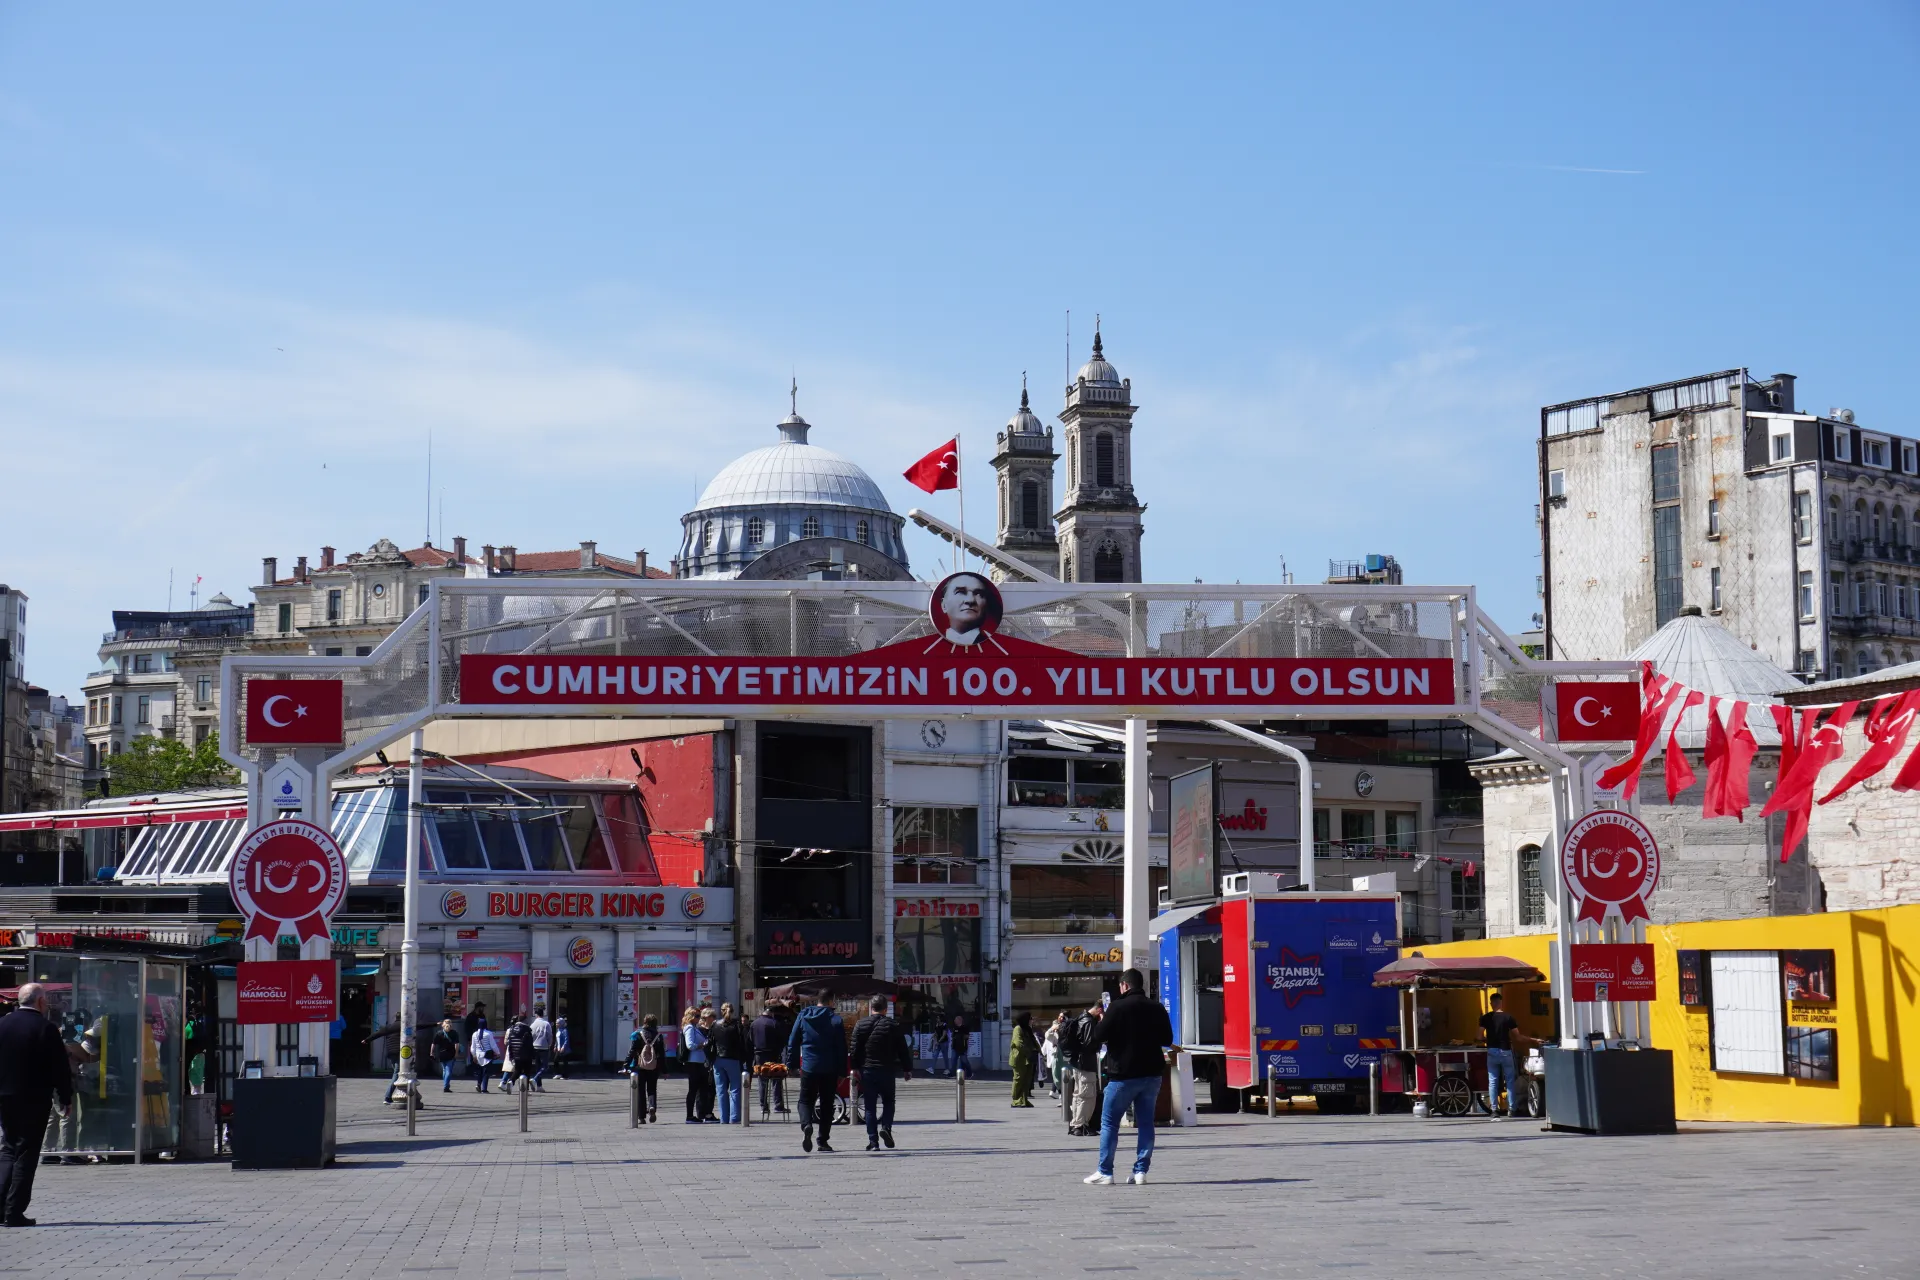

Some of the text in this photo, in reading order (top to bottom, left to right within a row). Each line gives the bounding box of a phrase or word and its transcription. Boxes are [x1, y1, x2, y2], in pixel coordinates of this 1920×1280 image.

[942, 667, 1032, 697] 100.
[1046, 667, 1125, 697] YILI
[1142, 667, 1275, 697] KUTLU
[1290, 667, 1430, 697] OLSUN
[1567, 816, 1654, 882] 29 EKİM CUMHURİYET BAYRAMI
[238, 826, 340, 899] 29 EKİM CUMHURİYET BAYRAMI
[446, 895, 466, 906] BURGER
[448, 900, 467, 912] KING
[489, 892, 665, 918] BURGER KING
[686, 896, 704, 906] BURGER
[687, 902, 704, 912] KING
[896, 898, 980, 916] Pehlivan
[572, 942, 592, 953] BURGER
[768, 930, 858, 959] simit sarayı
[573, 948, 594, 963] KING
[1063, 946, 1107, 968] Taksim
[1268, 964, 1324, 976] İSTANBUL
[1574, 971, 1614, 979] İMAMOĞLU
[897, 976, 936, 984] Pehlivan
[1272, 974, 1319, 990] Başardı
[240, 990, 286, 998] İMAMOĞLU
